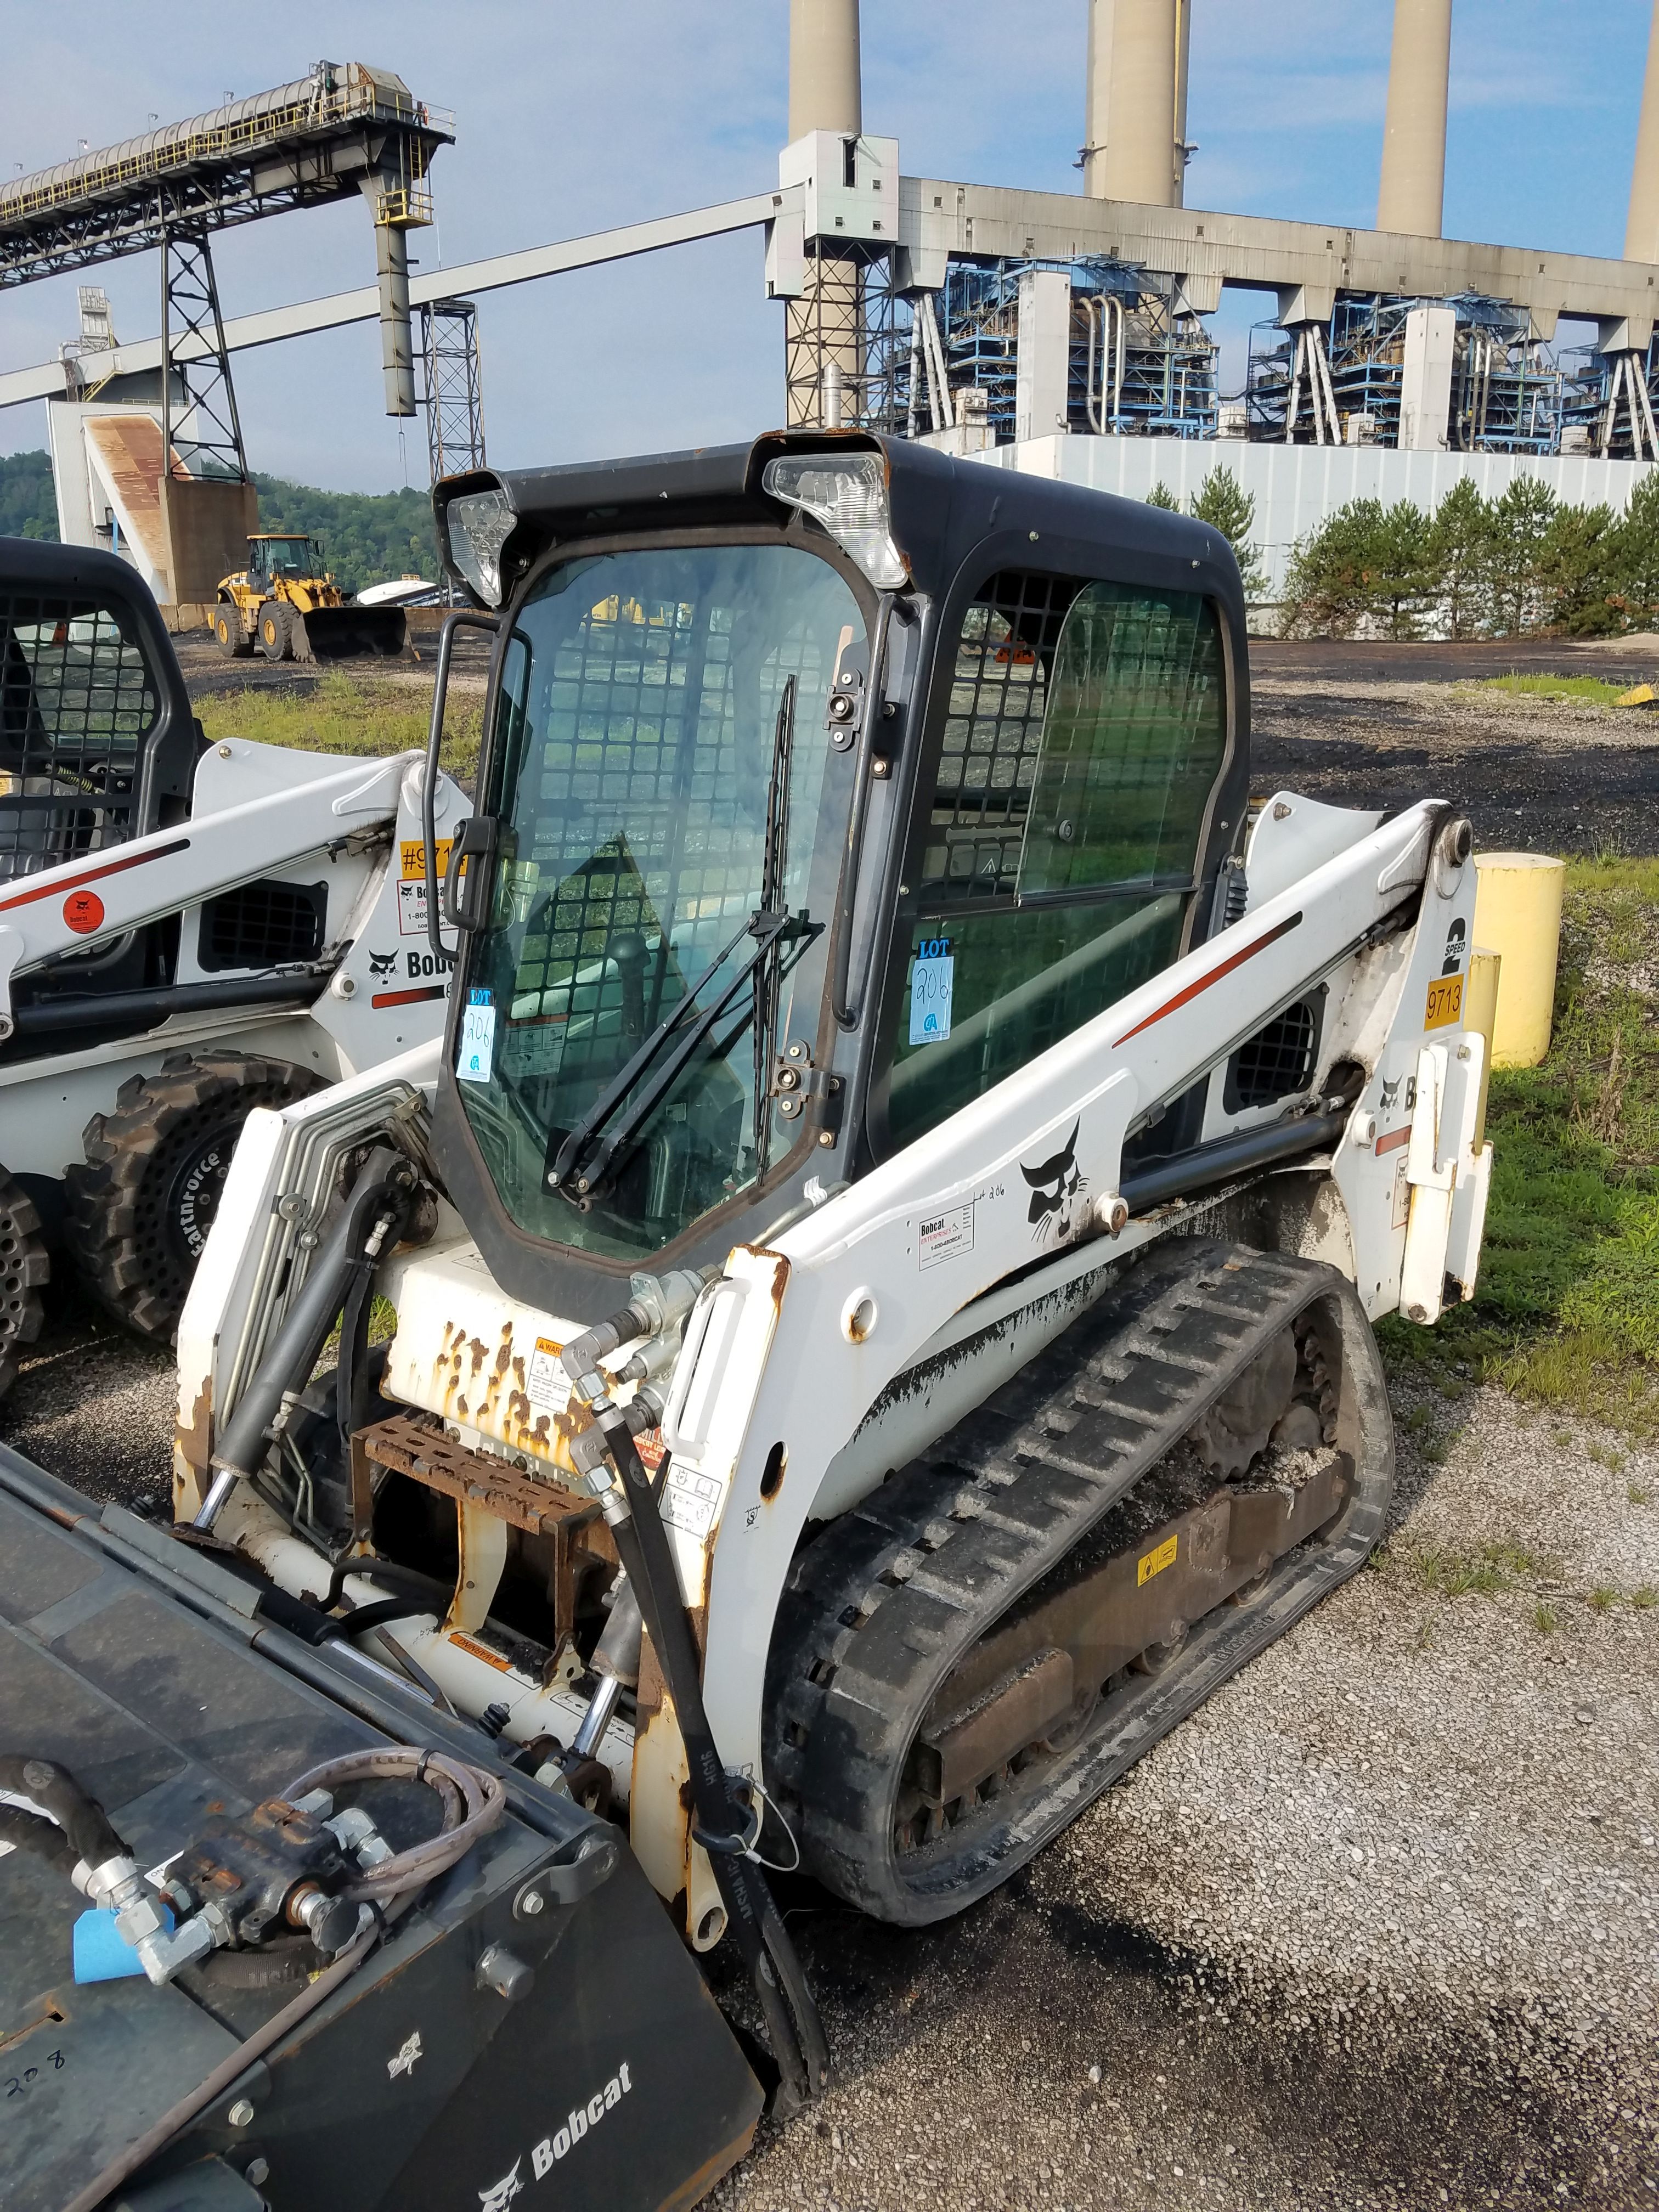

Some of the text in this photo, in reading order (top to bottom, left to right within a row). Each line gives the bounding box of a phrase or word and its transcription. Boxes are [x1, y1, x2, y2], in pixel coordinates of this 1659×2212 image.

[919, 939, 949, 959] LOT
[1442, 917, 1466, 976] 2
[1444, 941, 1466, 956] SPEED
[917, 965, 949, 1005] 206
[470, 989, 491, 1006] LOT
[1427, 984, 1461, 1019] 9713
[467, 1013, 490, 1047] 206
[989, 1184, 1005, 1199] 206
[921, 1218, 945, 1237] Bobcat
[921, 1228, 952, 1245] ENTERPRISES
[457, 1639, 494, 1662] WARNING
[5, 2050, 65, 2097] 208
[532, 2061, 632, 2181] Bobcat
